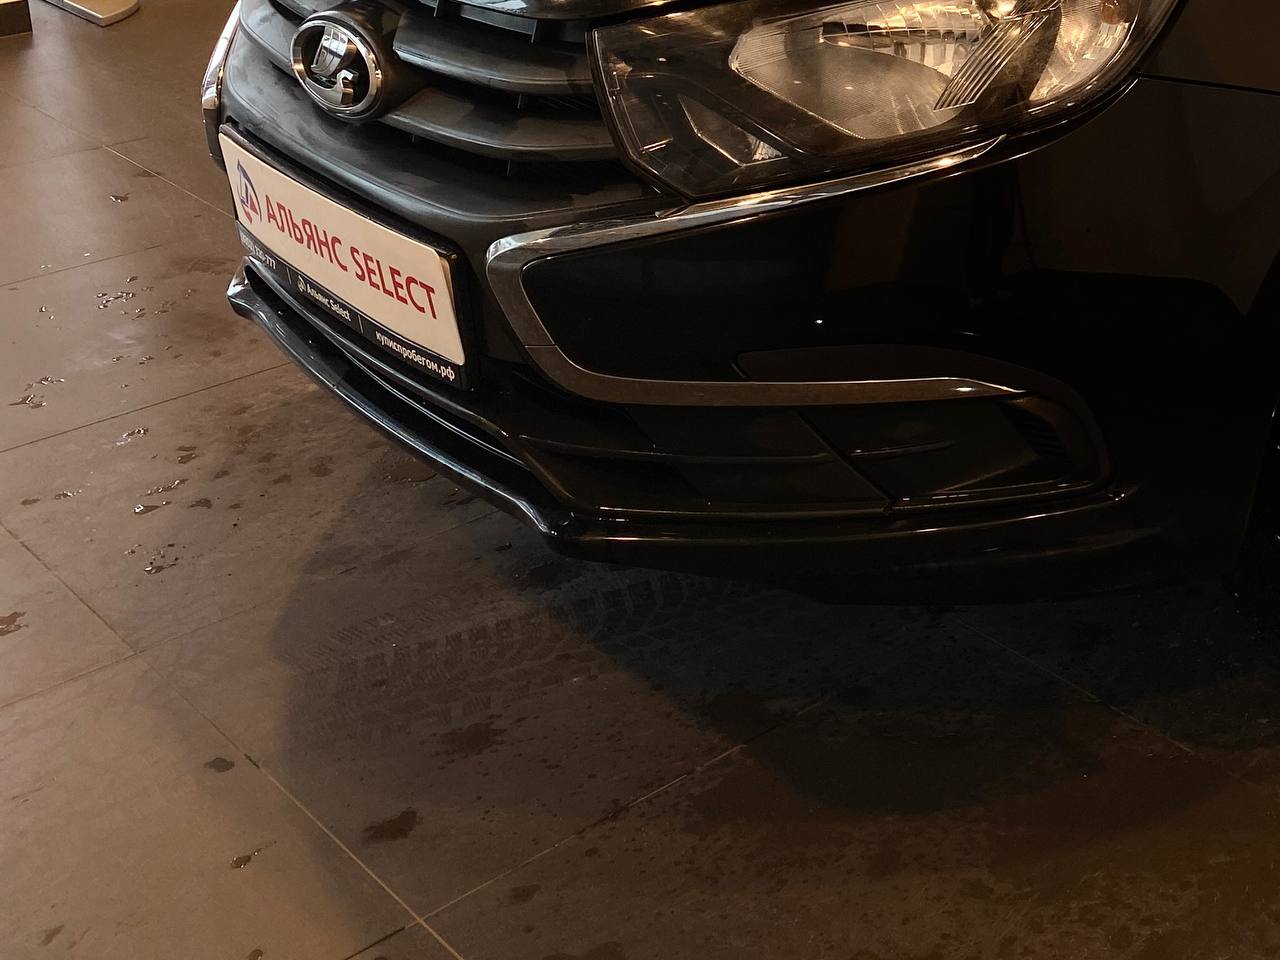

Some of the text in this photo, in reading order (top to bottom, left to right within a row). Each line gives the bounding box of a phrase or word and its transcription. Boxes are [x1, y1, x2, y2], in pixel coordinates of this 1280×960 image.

[265, 194, 437, 320] АЛЬЯНС SELECT
[375, 330, 455, 382] куписпробегом.рф
